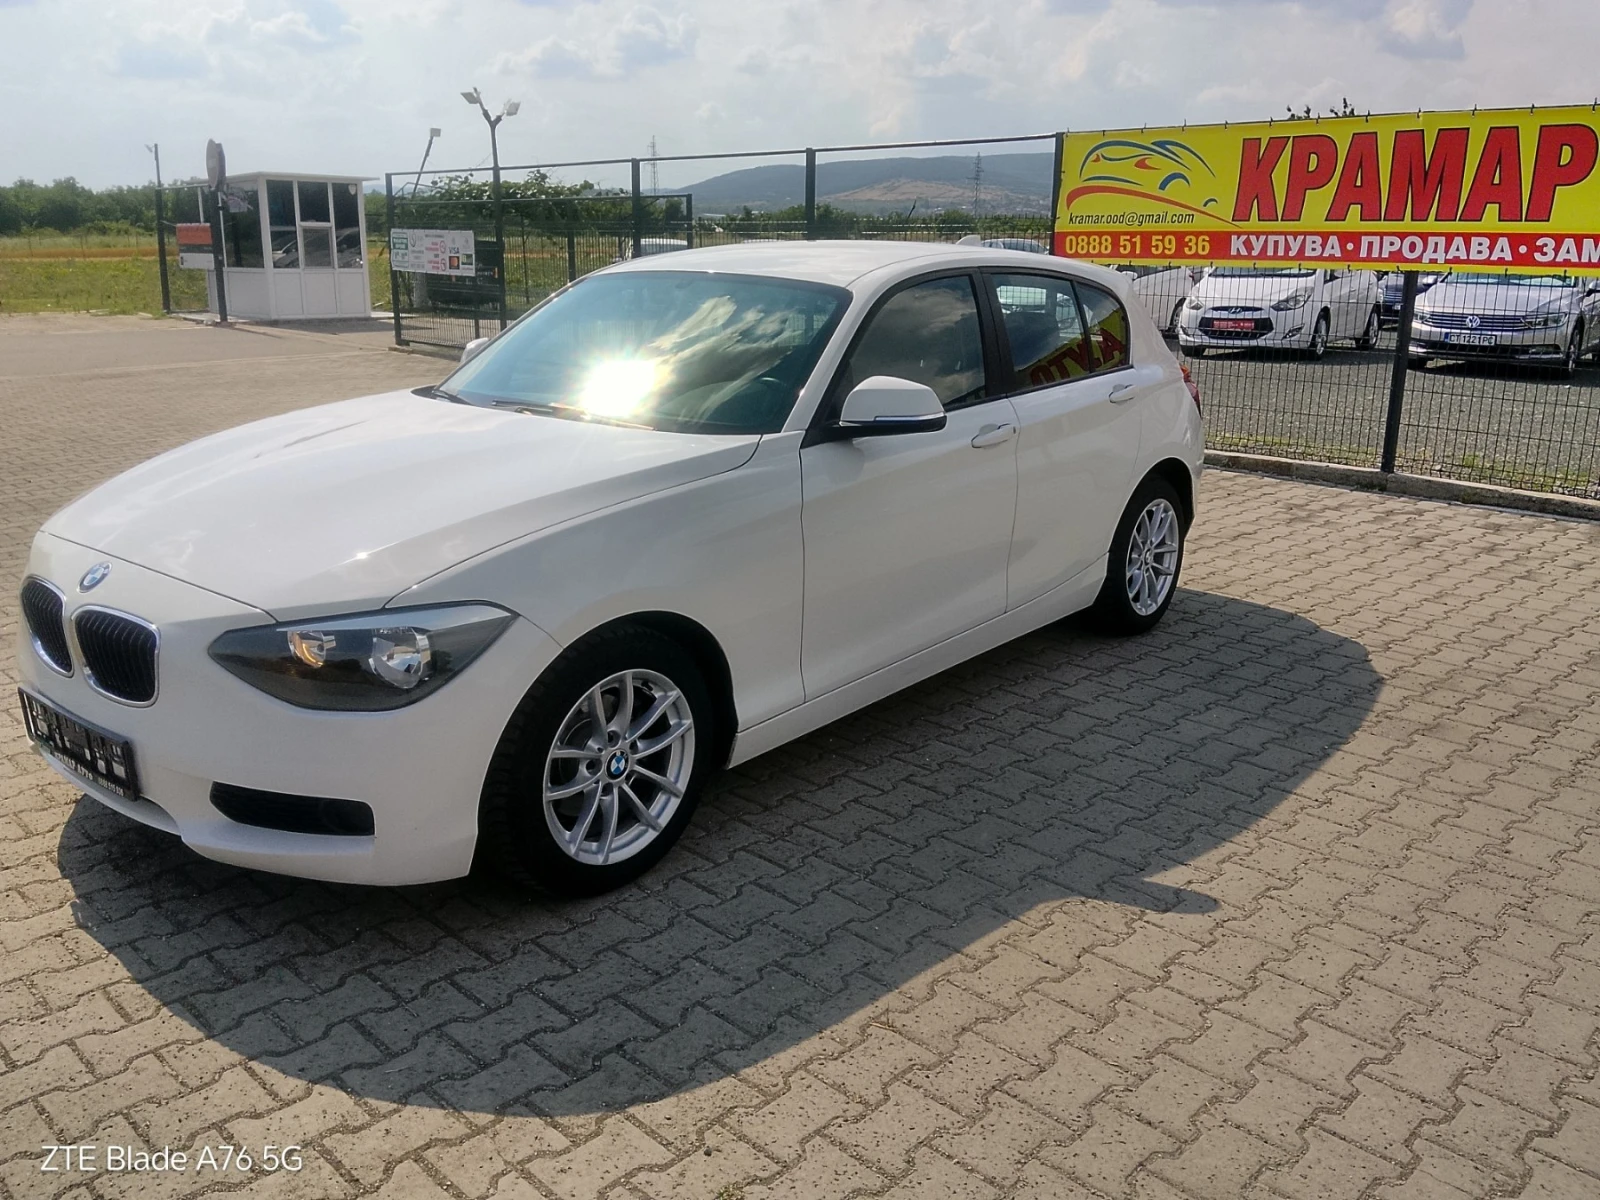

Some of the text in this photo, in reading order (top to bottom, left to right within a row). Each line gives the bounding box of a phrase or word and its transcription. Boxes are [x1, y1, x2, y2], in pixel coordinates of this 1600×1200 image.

[1231, 123, 1600, 222] КРАМАР
[1068, 212, 1195, 227] kramar.ood@gmail.com
[1065, 234, 1210, 255] 0888 51 59 36
[1230, 235, 1342, 257] КУПУВА
[1359, 236, 1513, 263] ПРОДАВА
